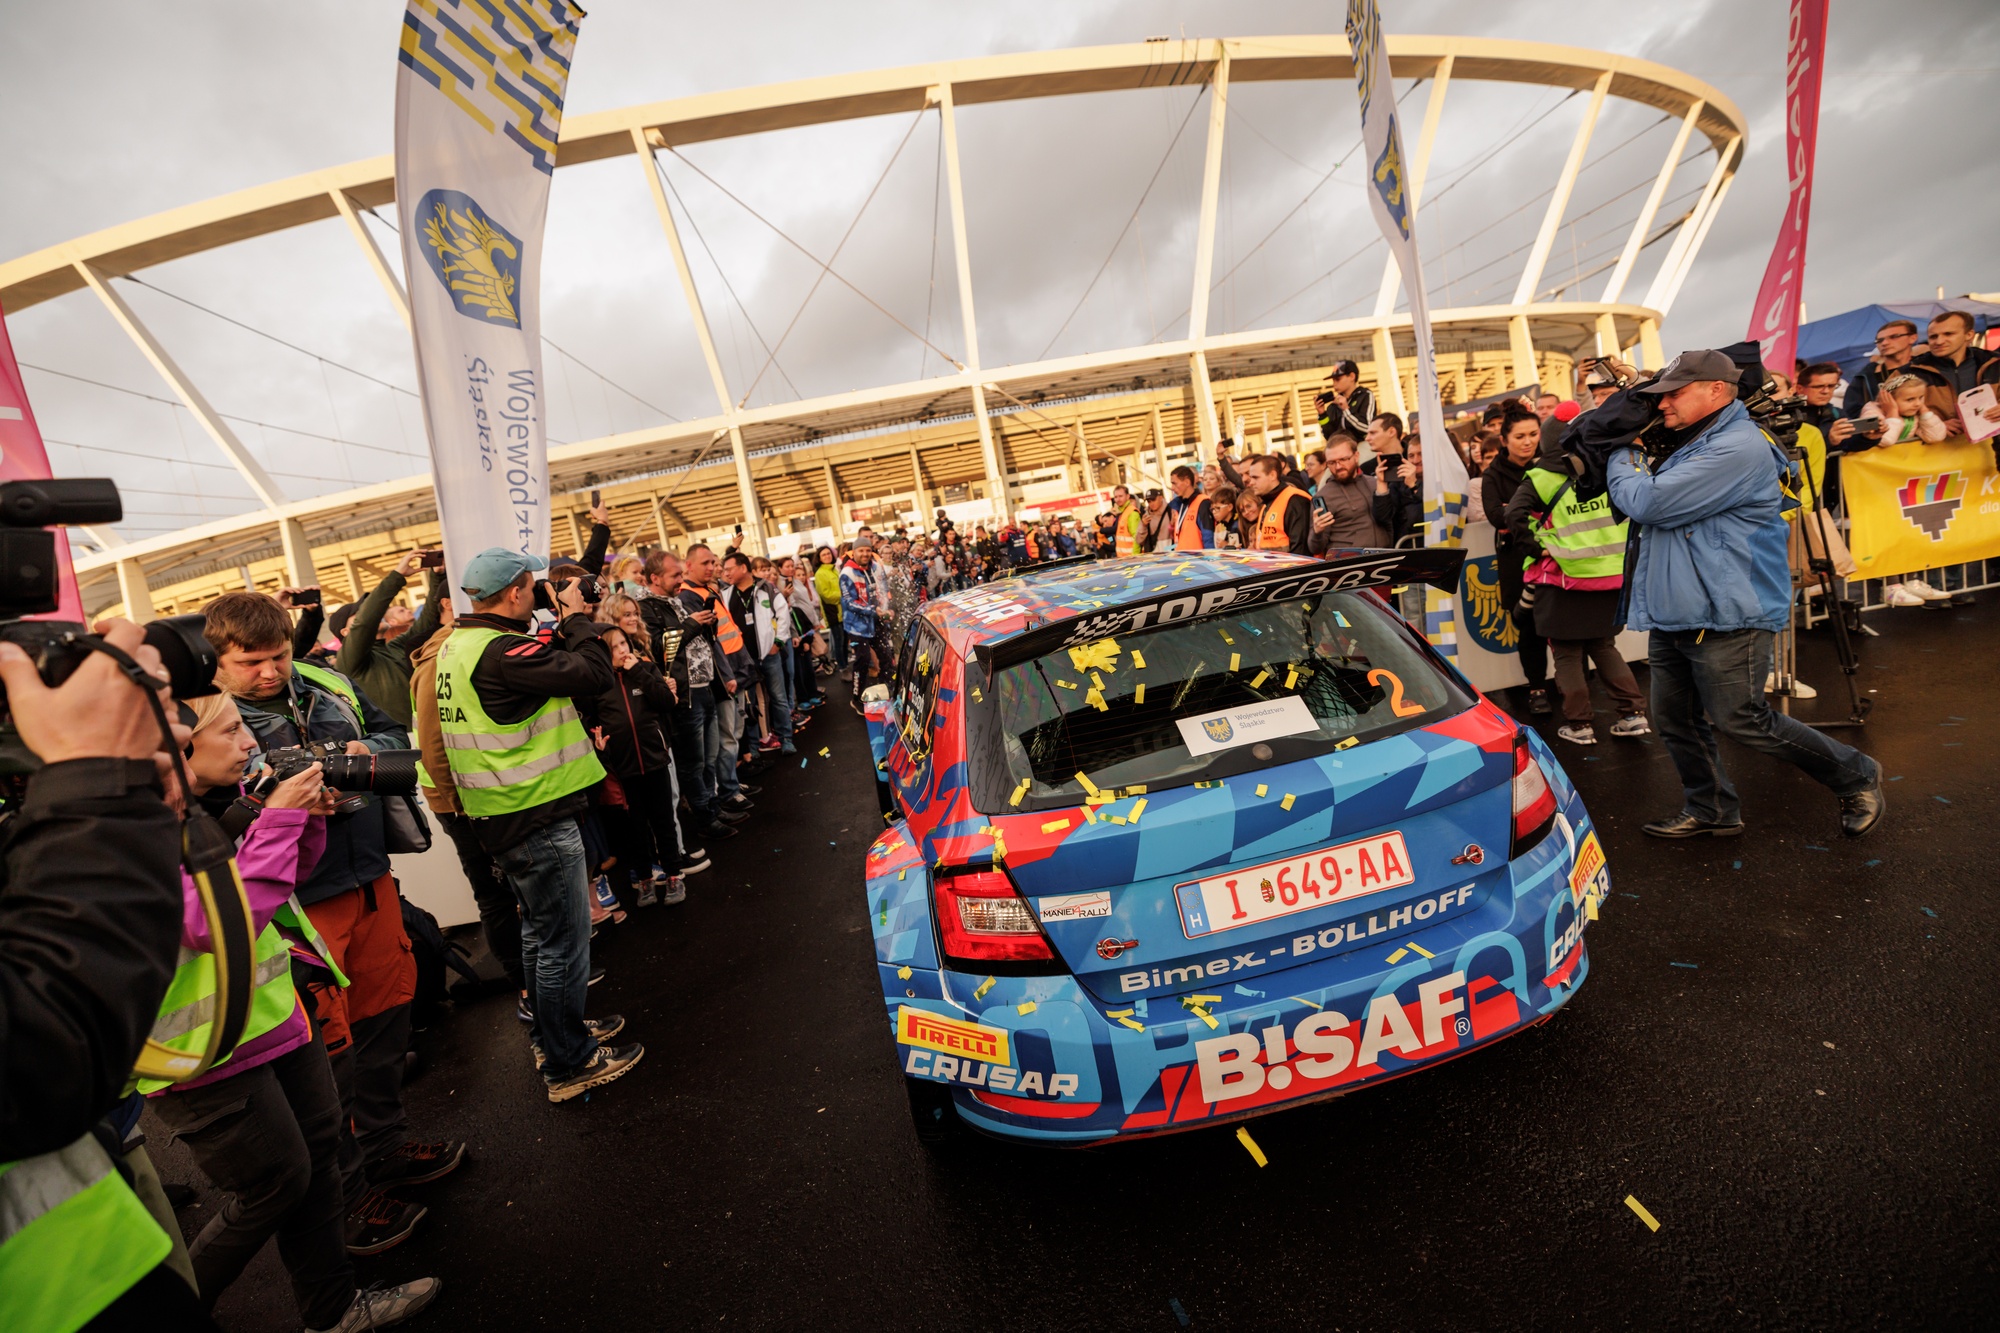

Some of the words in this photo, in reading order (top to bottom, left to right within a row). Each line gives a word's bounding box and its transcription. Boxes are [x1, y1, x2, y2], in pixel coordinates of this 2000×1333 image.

[1566, 499, 1611, 516] MEDI
[1267, 564, 1400, 601] CARS
[437, 672, 452, 700] 25
[1367, 668, 1427, 718] 2
[439, 707, 467, 723] EDIA
[1234, 706, 1285, 722] Województwo
[1239, 718, 1266, 729] Śląskie
[1573, 841, 1600, 898] PIRELLI
[1189, 913, 1203, 929] H
[907, 1014, 998, 1057] PIRELLI
[905, 1049, 1079, 1097] CRUSAR
